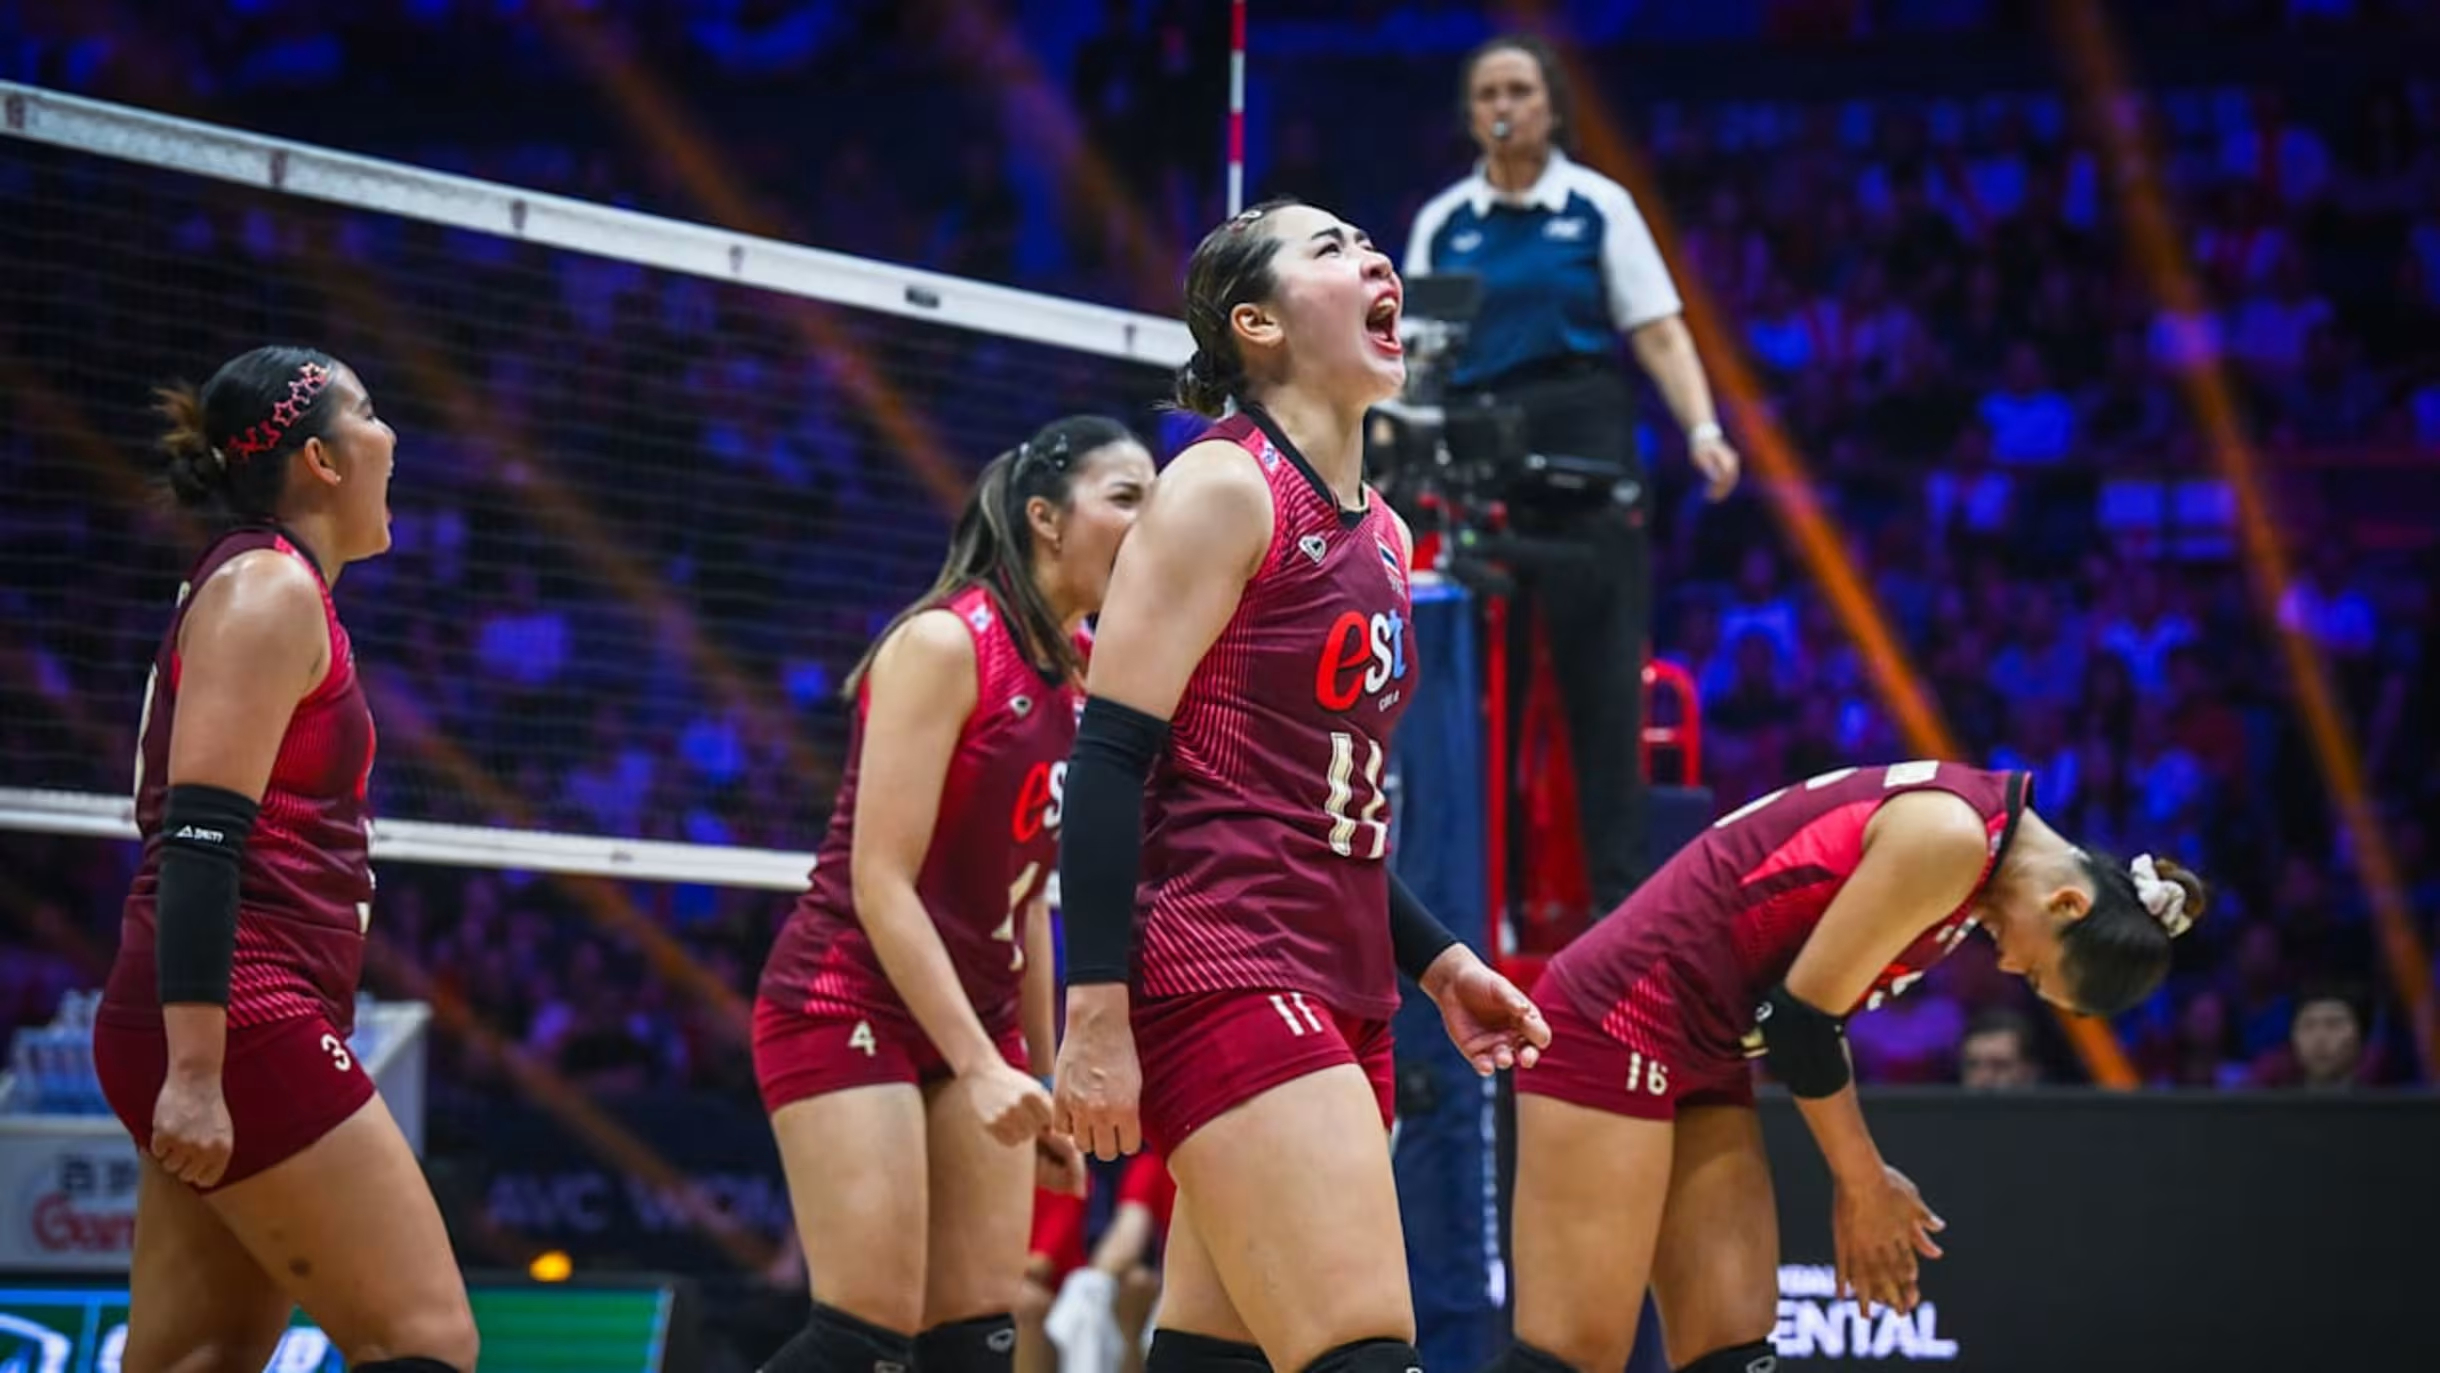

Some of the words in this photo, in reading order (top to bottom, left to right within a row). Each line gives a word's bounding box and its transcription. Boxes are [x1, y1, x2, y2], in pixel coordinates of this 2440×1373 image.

[1316, 608, 1406, 712] est
[1012, 761, 1068, 844] es
[1268, 991, 1323, 1036] 11
[320, 1033, 351, 1072] 3
[848, 1020, 876, 1056] 4
[1626, 1051, 1668, 1096] 16
